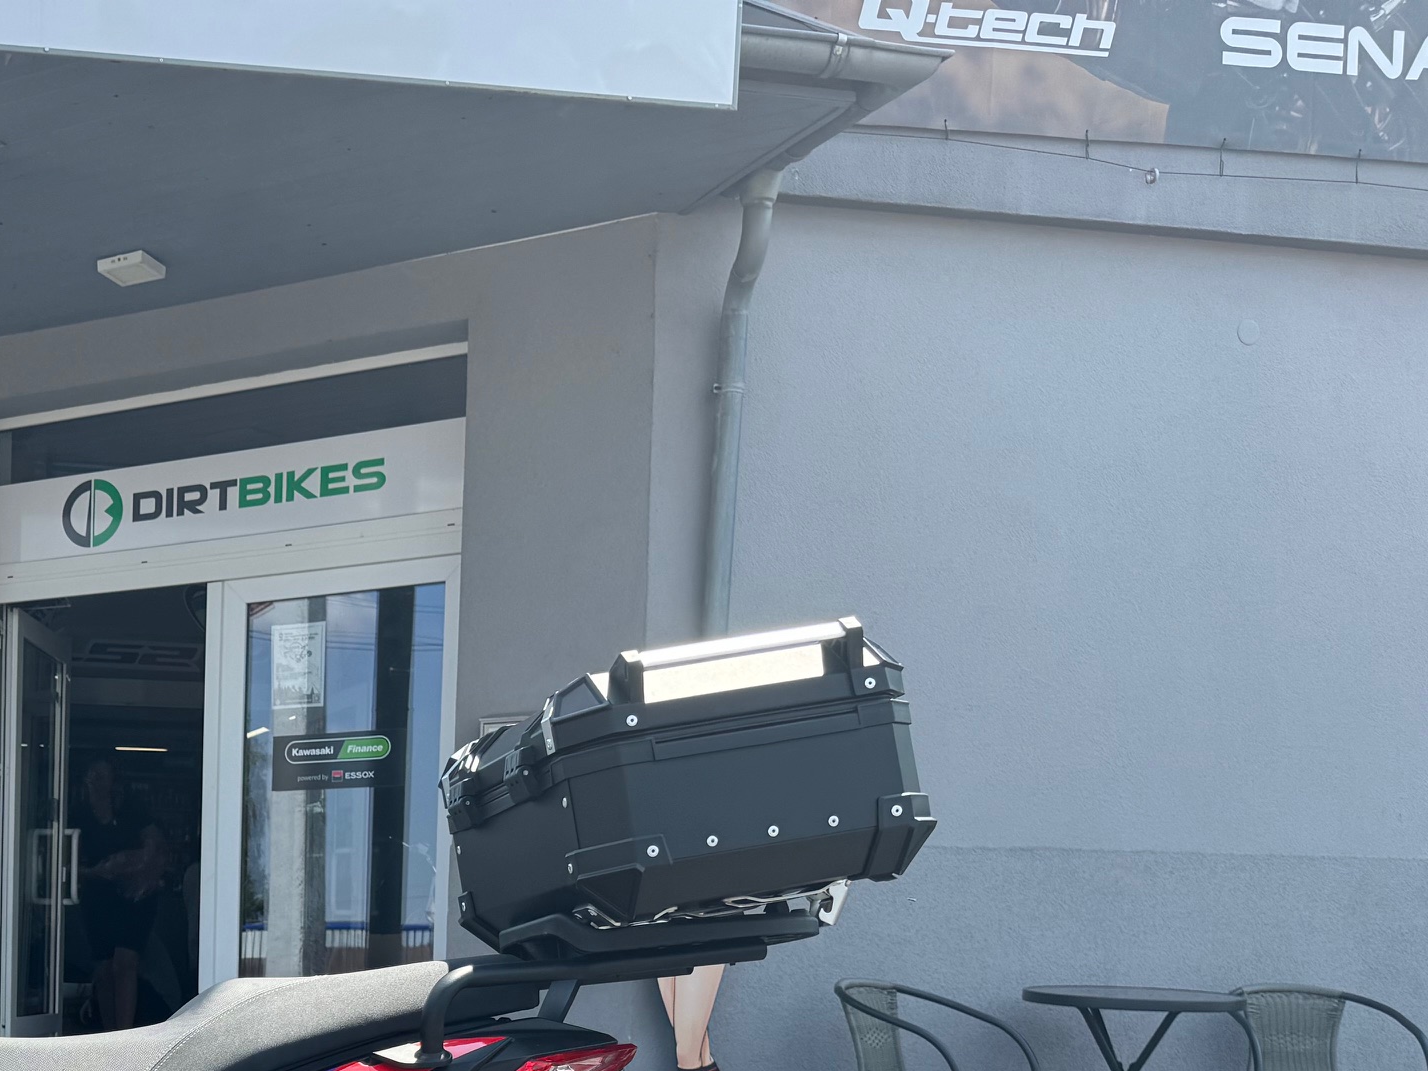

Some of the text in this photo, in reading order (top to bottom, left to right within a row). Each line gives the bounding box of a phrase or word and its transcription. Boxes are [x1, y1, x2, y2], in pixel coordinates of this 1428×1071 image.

[132, 457, 387, 523] DIRTBIKES
[291, 743, 384, 757] Kawasaki Finance
[297, 770, 375, 783] powered by ESSOX
